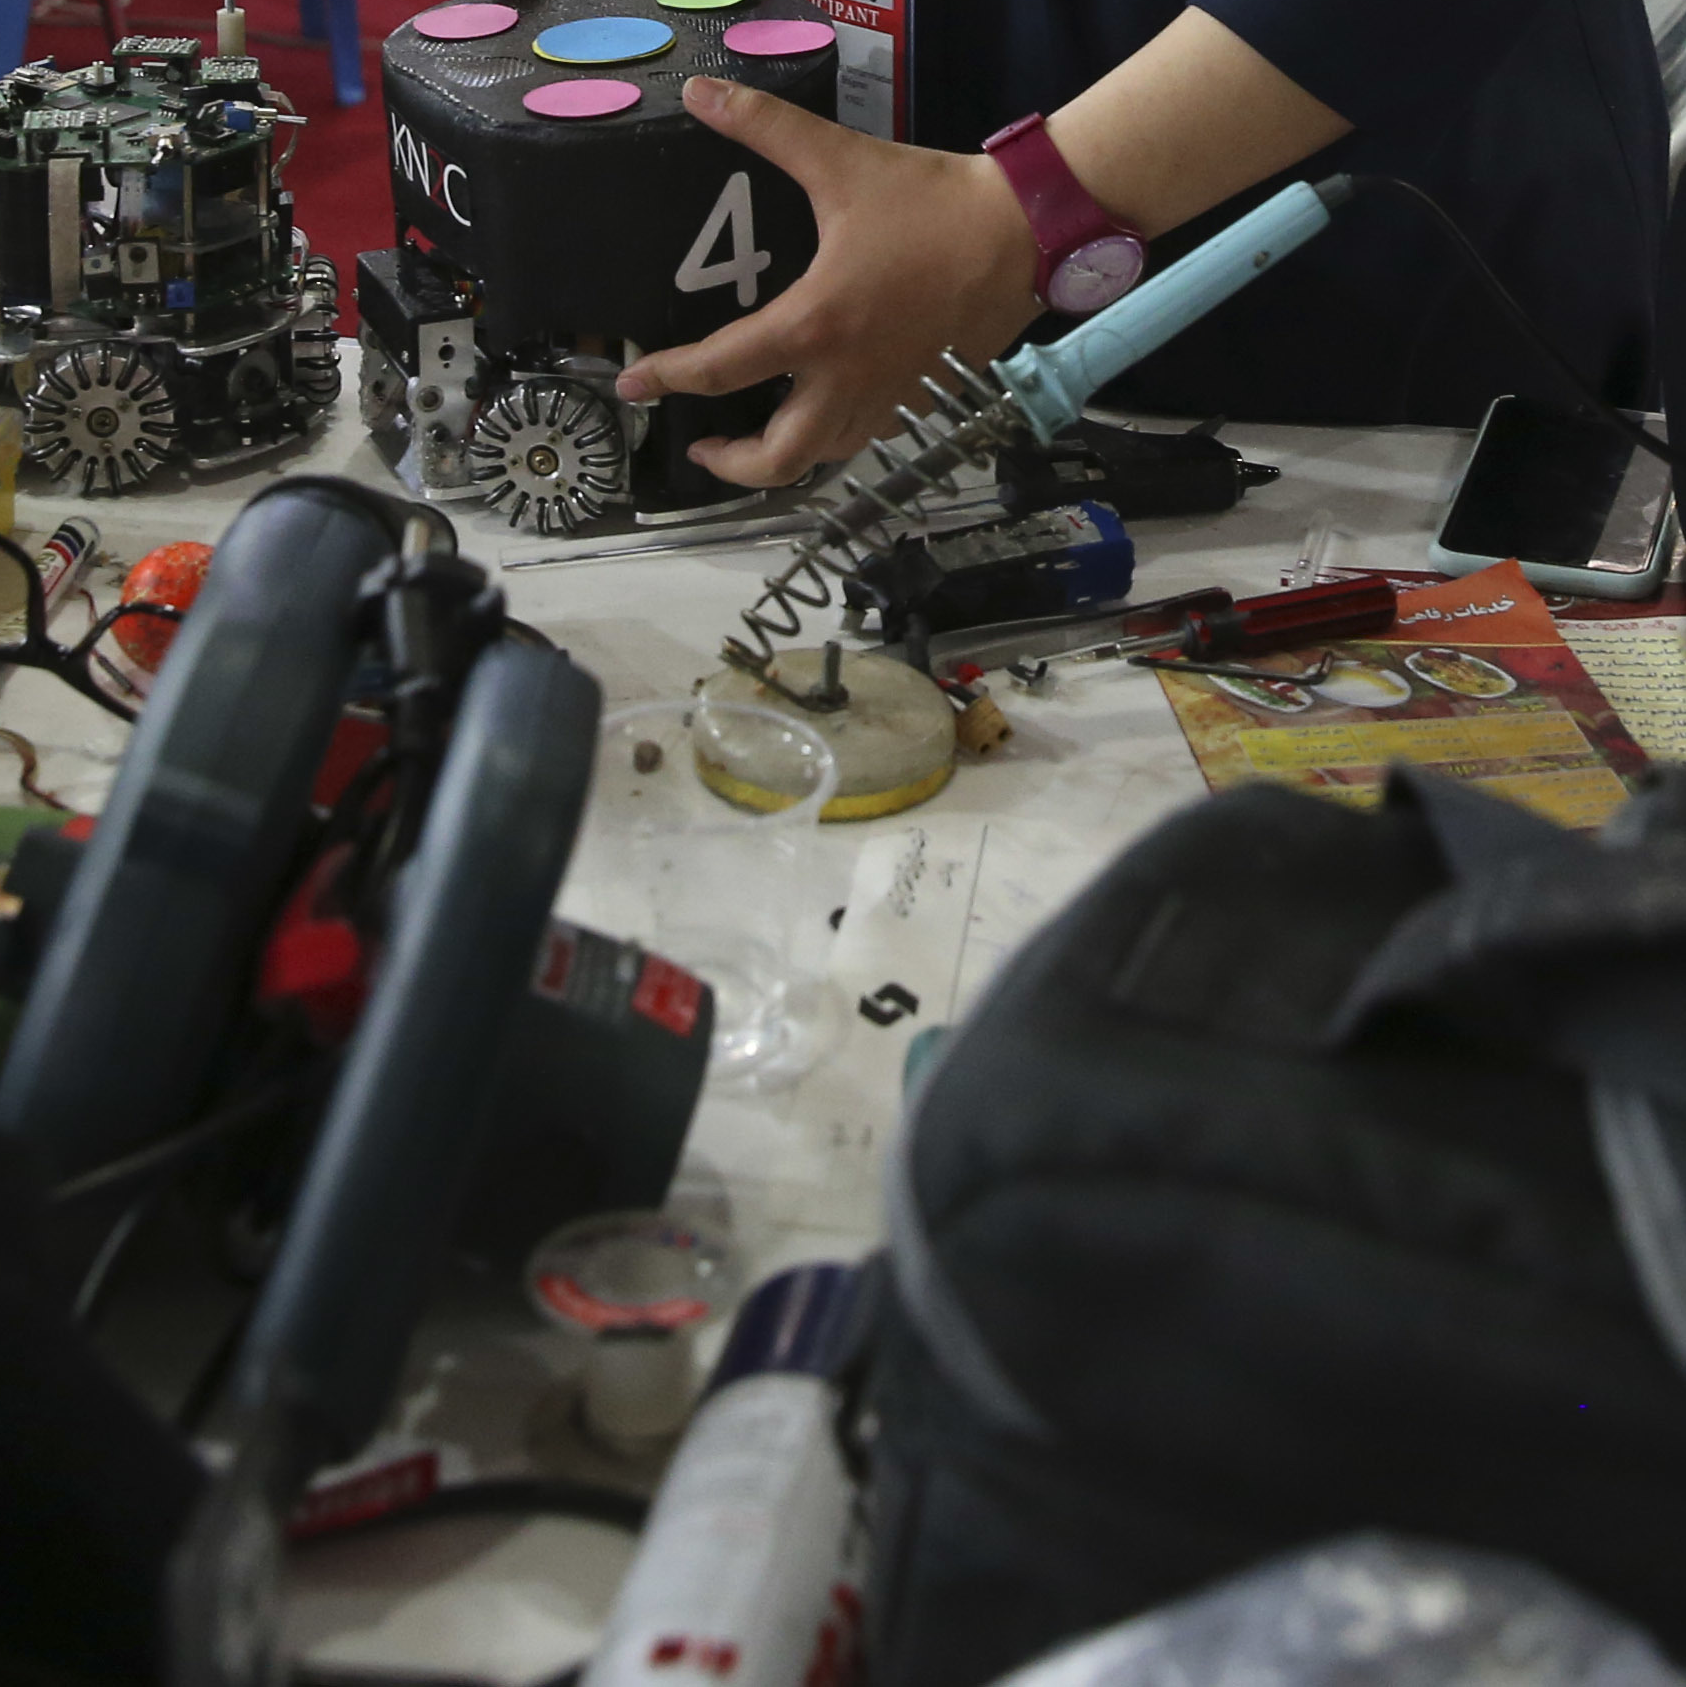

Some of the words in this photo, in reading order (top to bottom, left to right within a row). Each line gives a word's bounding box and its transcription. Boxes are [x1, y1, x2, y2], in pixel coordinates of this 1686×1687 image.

[674, 171, 771, 308] 4
[1397, 607, 1454, 625] رفاهی
[1456, 593, 1516, 619] خدمات
